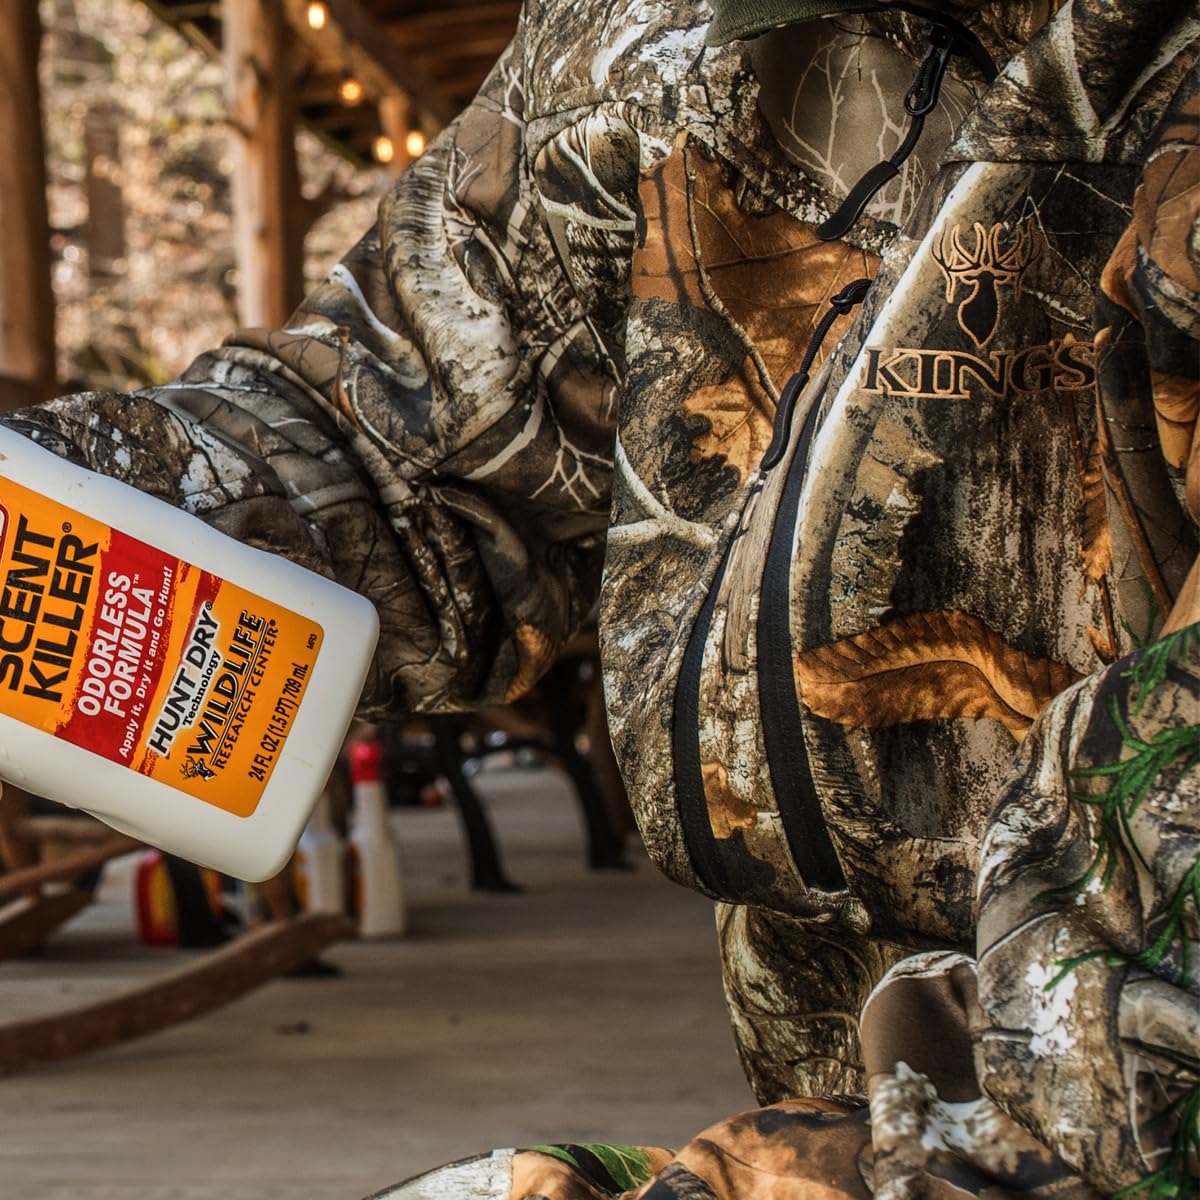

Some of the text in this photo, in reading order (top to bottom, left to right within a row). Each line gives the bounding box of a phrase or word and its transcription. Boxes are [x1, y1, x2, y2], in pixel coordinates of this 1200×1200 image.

[153, 605, 165, 628] Go
[158, 566, 173, 606] Hunt!
[77, 571, 131, 717] ODORLESS
[135, 660, 152, 700] Dry
[148, 629, 161, 658] and
[149, 667, 197, 755] HUNT
[182, 650, 221, 727] Technology
[186, 610, 265, 755] WILDLIFE
[118, 715, 139, 758] Apply
[215, 688, 256, 770] RESEARCH
[248, 662, 309, 782] 24 FL OZ (1.5 PT) 709 mL
